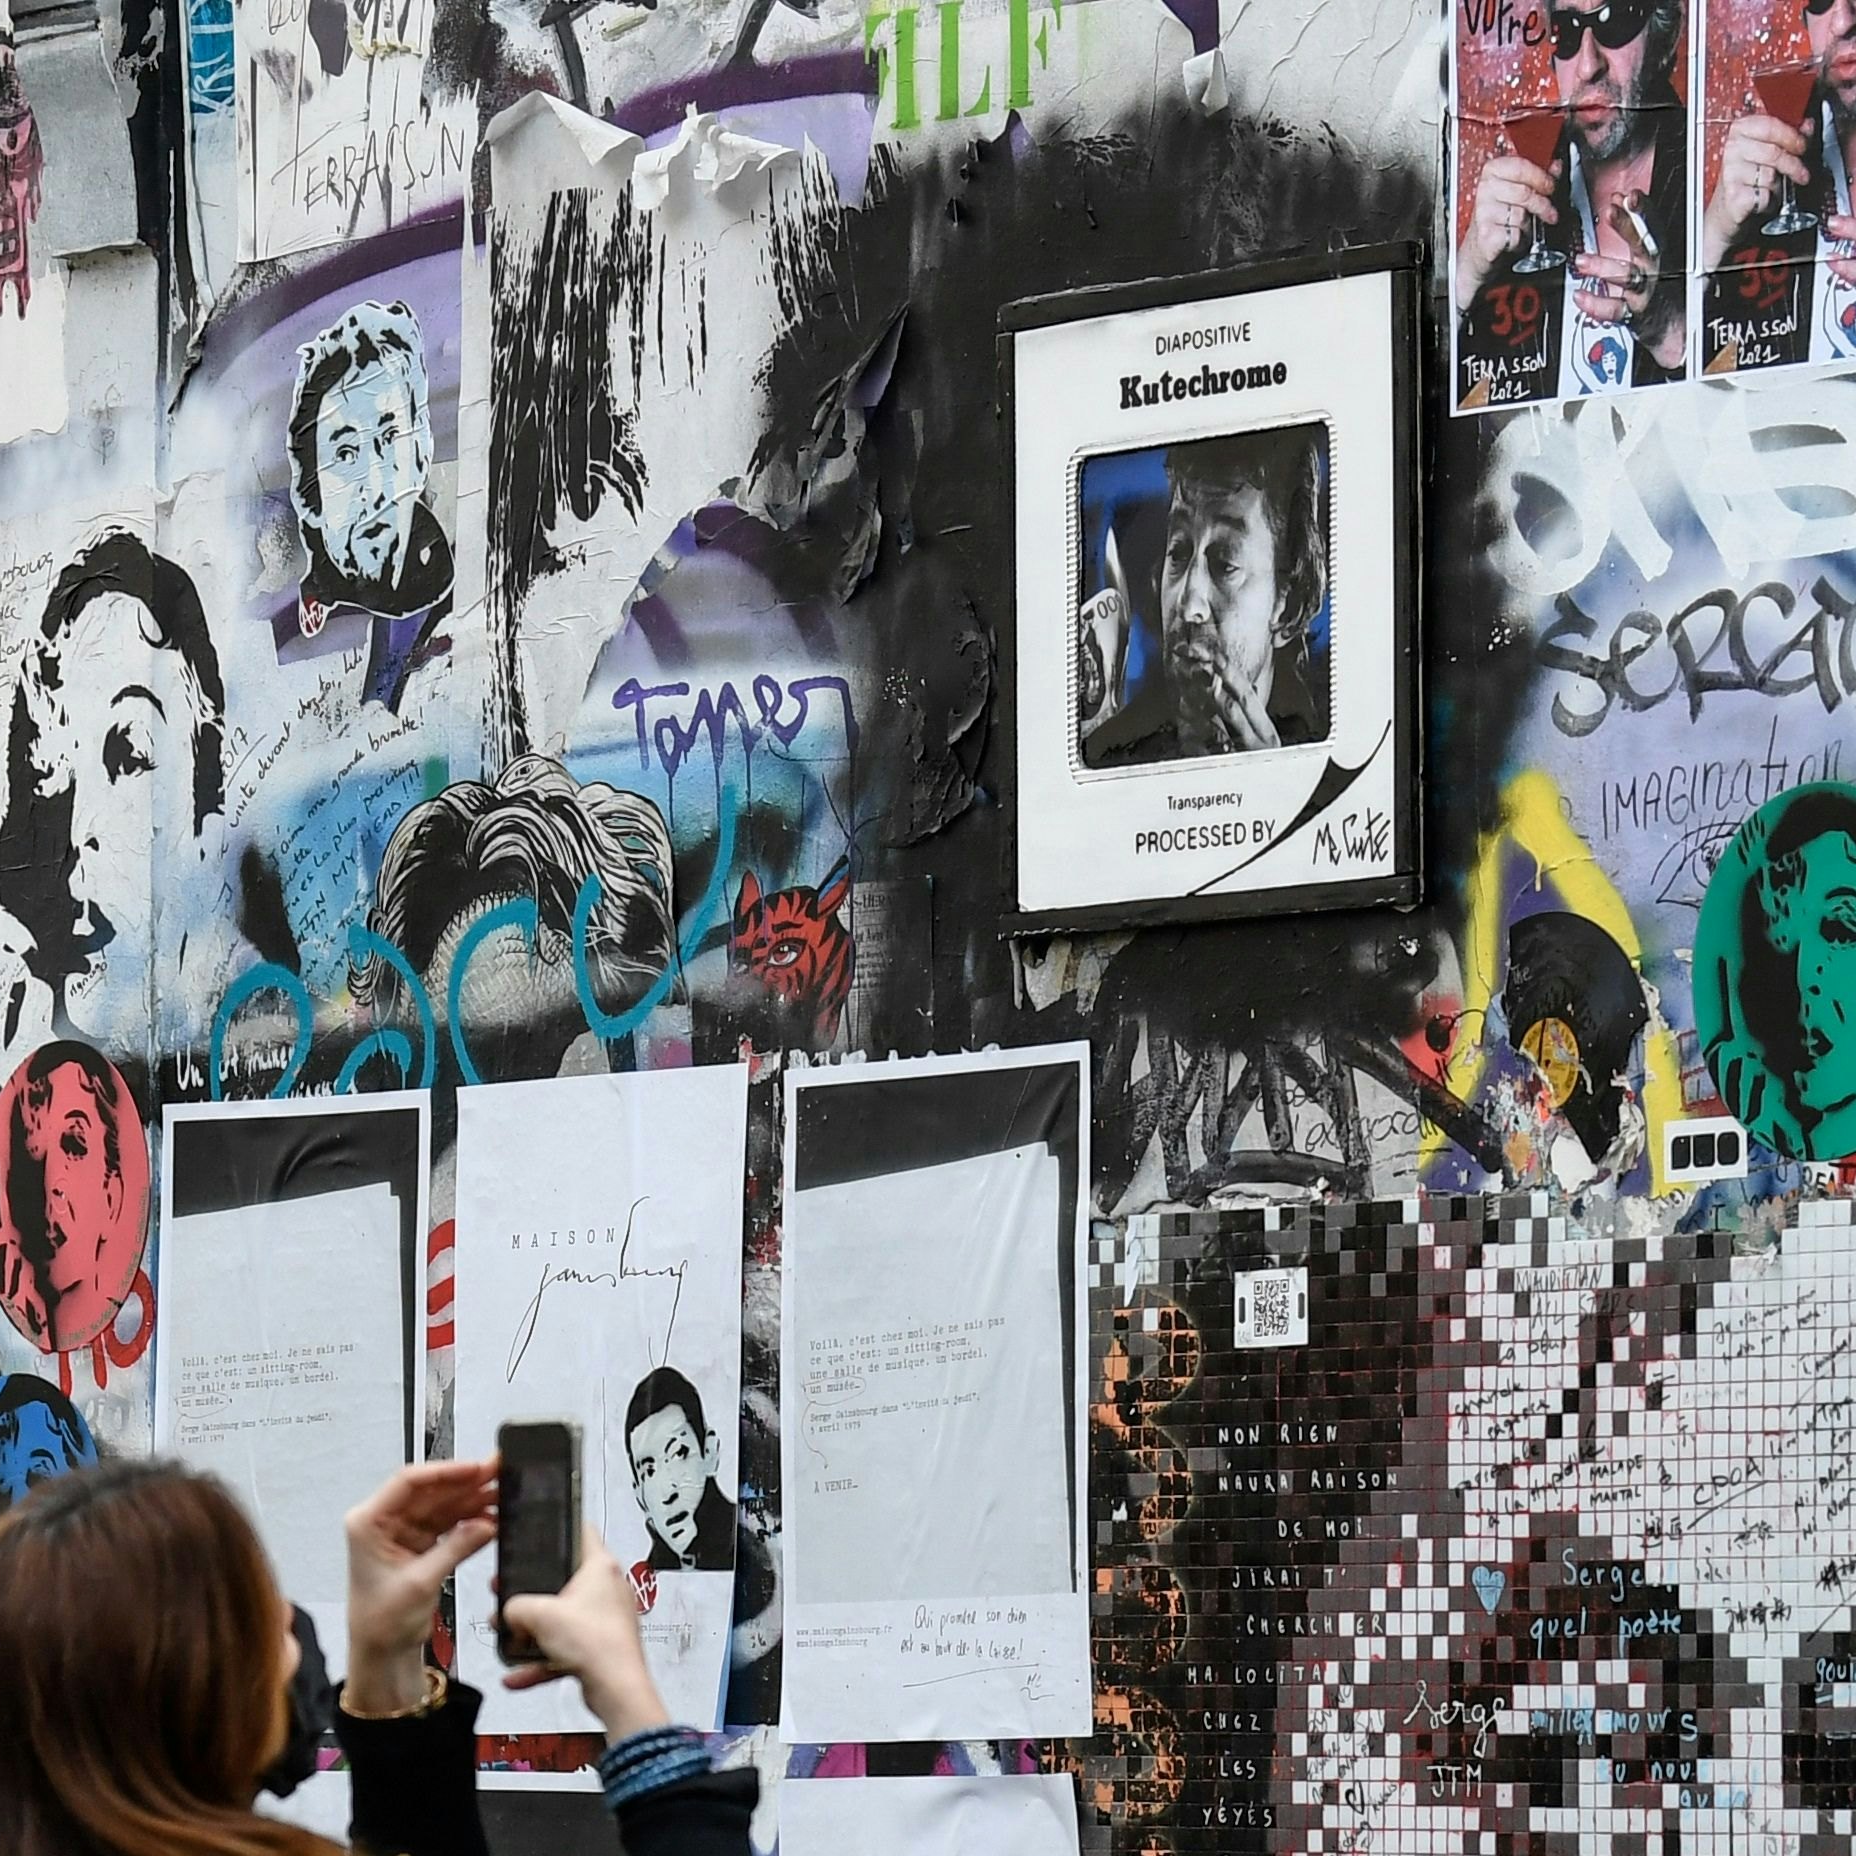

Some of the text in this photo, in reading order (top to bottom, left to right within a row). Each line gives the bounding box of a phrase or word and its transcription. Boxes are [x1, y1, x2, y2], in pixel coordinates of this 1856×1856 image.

[1154, 322, 1252, 357] DIAPOSITIVE
[1119, 360, 1288, 410] Kutechrome
[1167, 792, 1243, 813] Transparency
[1135, 819, 1277, 856] PROCESSED BY
[511, 1228, 619, 1249] MAISON
[849, 1334, 876, 1347] c'est
[881, 1331, 904, 1344] chez
[907, 1328, 929, 1340] moi.
[932, 1325, 946, 1337] Je
[947, 1323, 960, 1334] ne
[964, 1320, 984, 1332] sais
[988, 1317, 1006, 1332] pas
[809, 1346, 900, 1367] ce que c'est: un
[809, 1354, 948, 1381] une salle de un
[809, 1384, 823, 1395] un
[1218, 1425, 1261, 1448] NON
[1278, 1518, 1305, 1539] DE
[1529, 1608, 1589, 1659] quel
[1618, 1607, 1683, 1660] poète
[1203, 1712, 1262, 1732] CHEZ
[1219, 1757, 1257, 1778] LES
[1426, 1762, 1484, 1800] JTM
